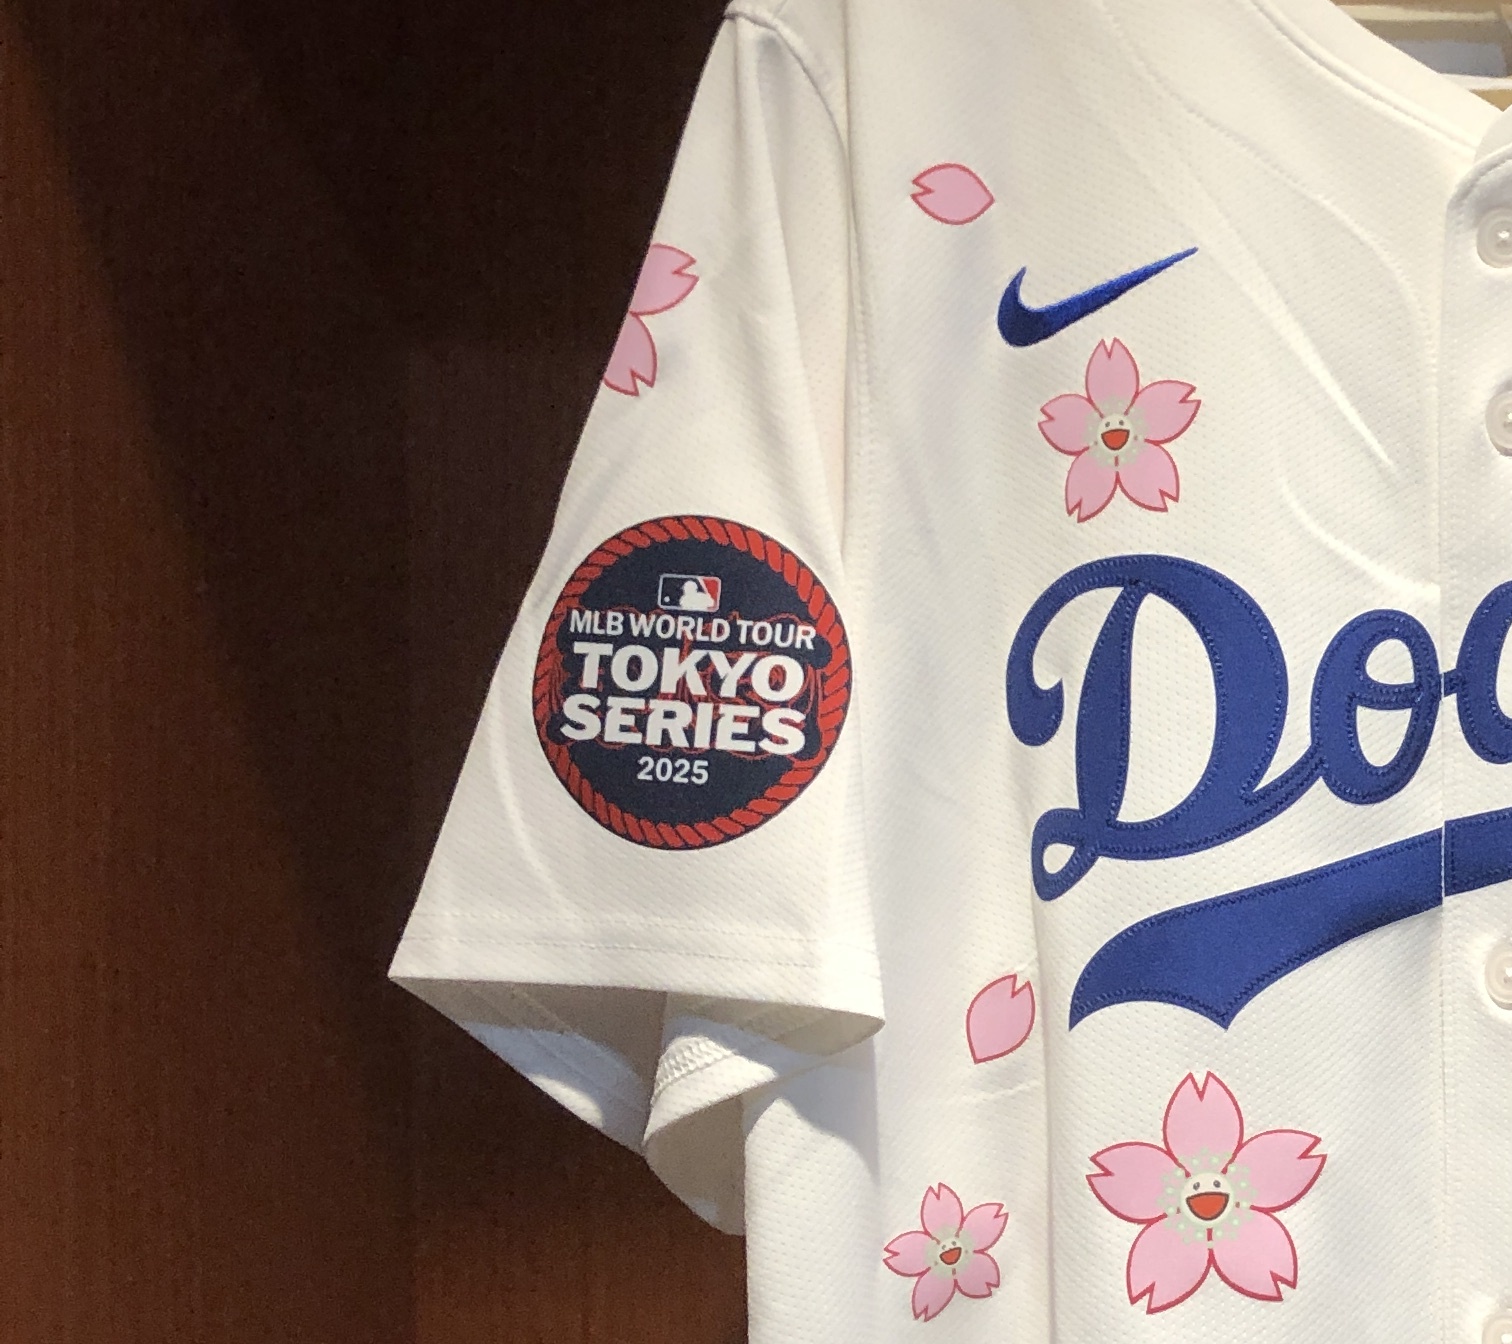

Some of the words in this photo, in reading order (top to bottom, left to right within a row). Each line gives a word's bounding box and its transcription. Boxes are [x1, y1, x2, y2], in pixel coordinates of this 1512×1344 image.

[569, 609, 624, 636] MLB
[629, 614, 731, 642] WORLD
[737, 619, 817, 650] TOUR
[573, 641, 805, 702] TOKYO
[559, 693, 806, 756] SERIES
[637, 756, 709, 785] 2025
